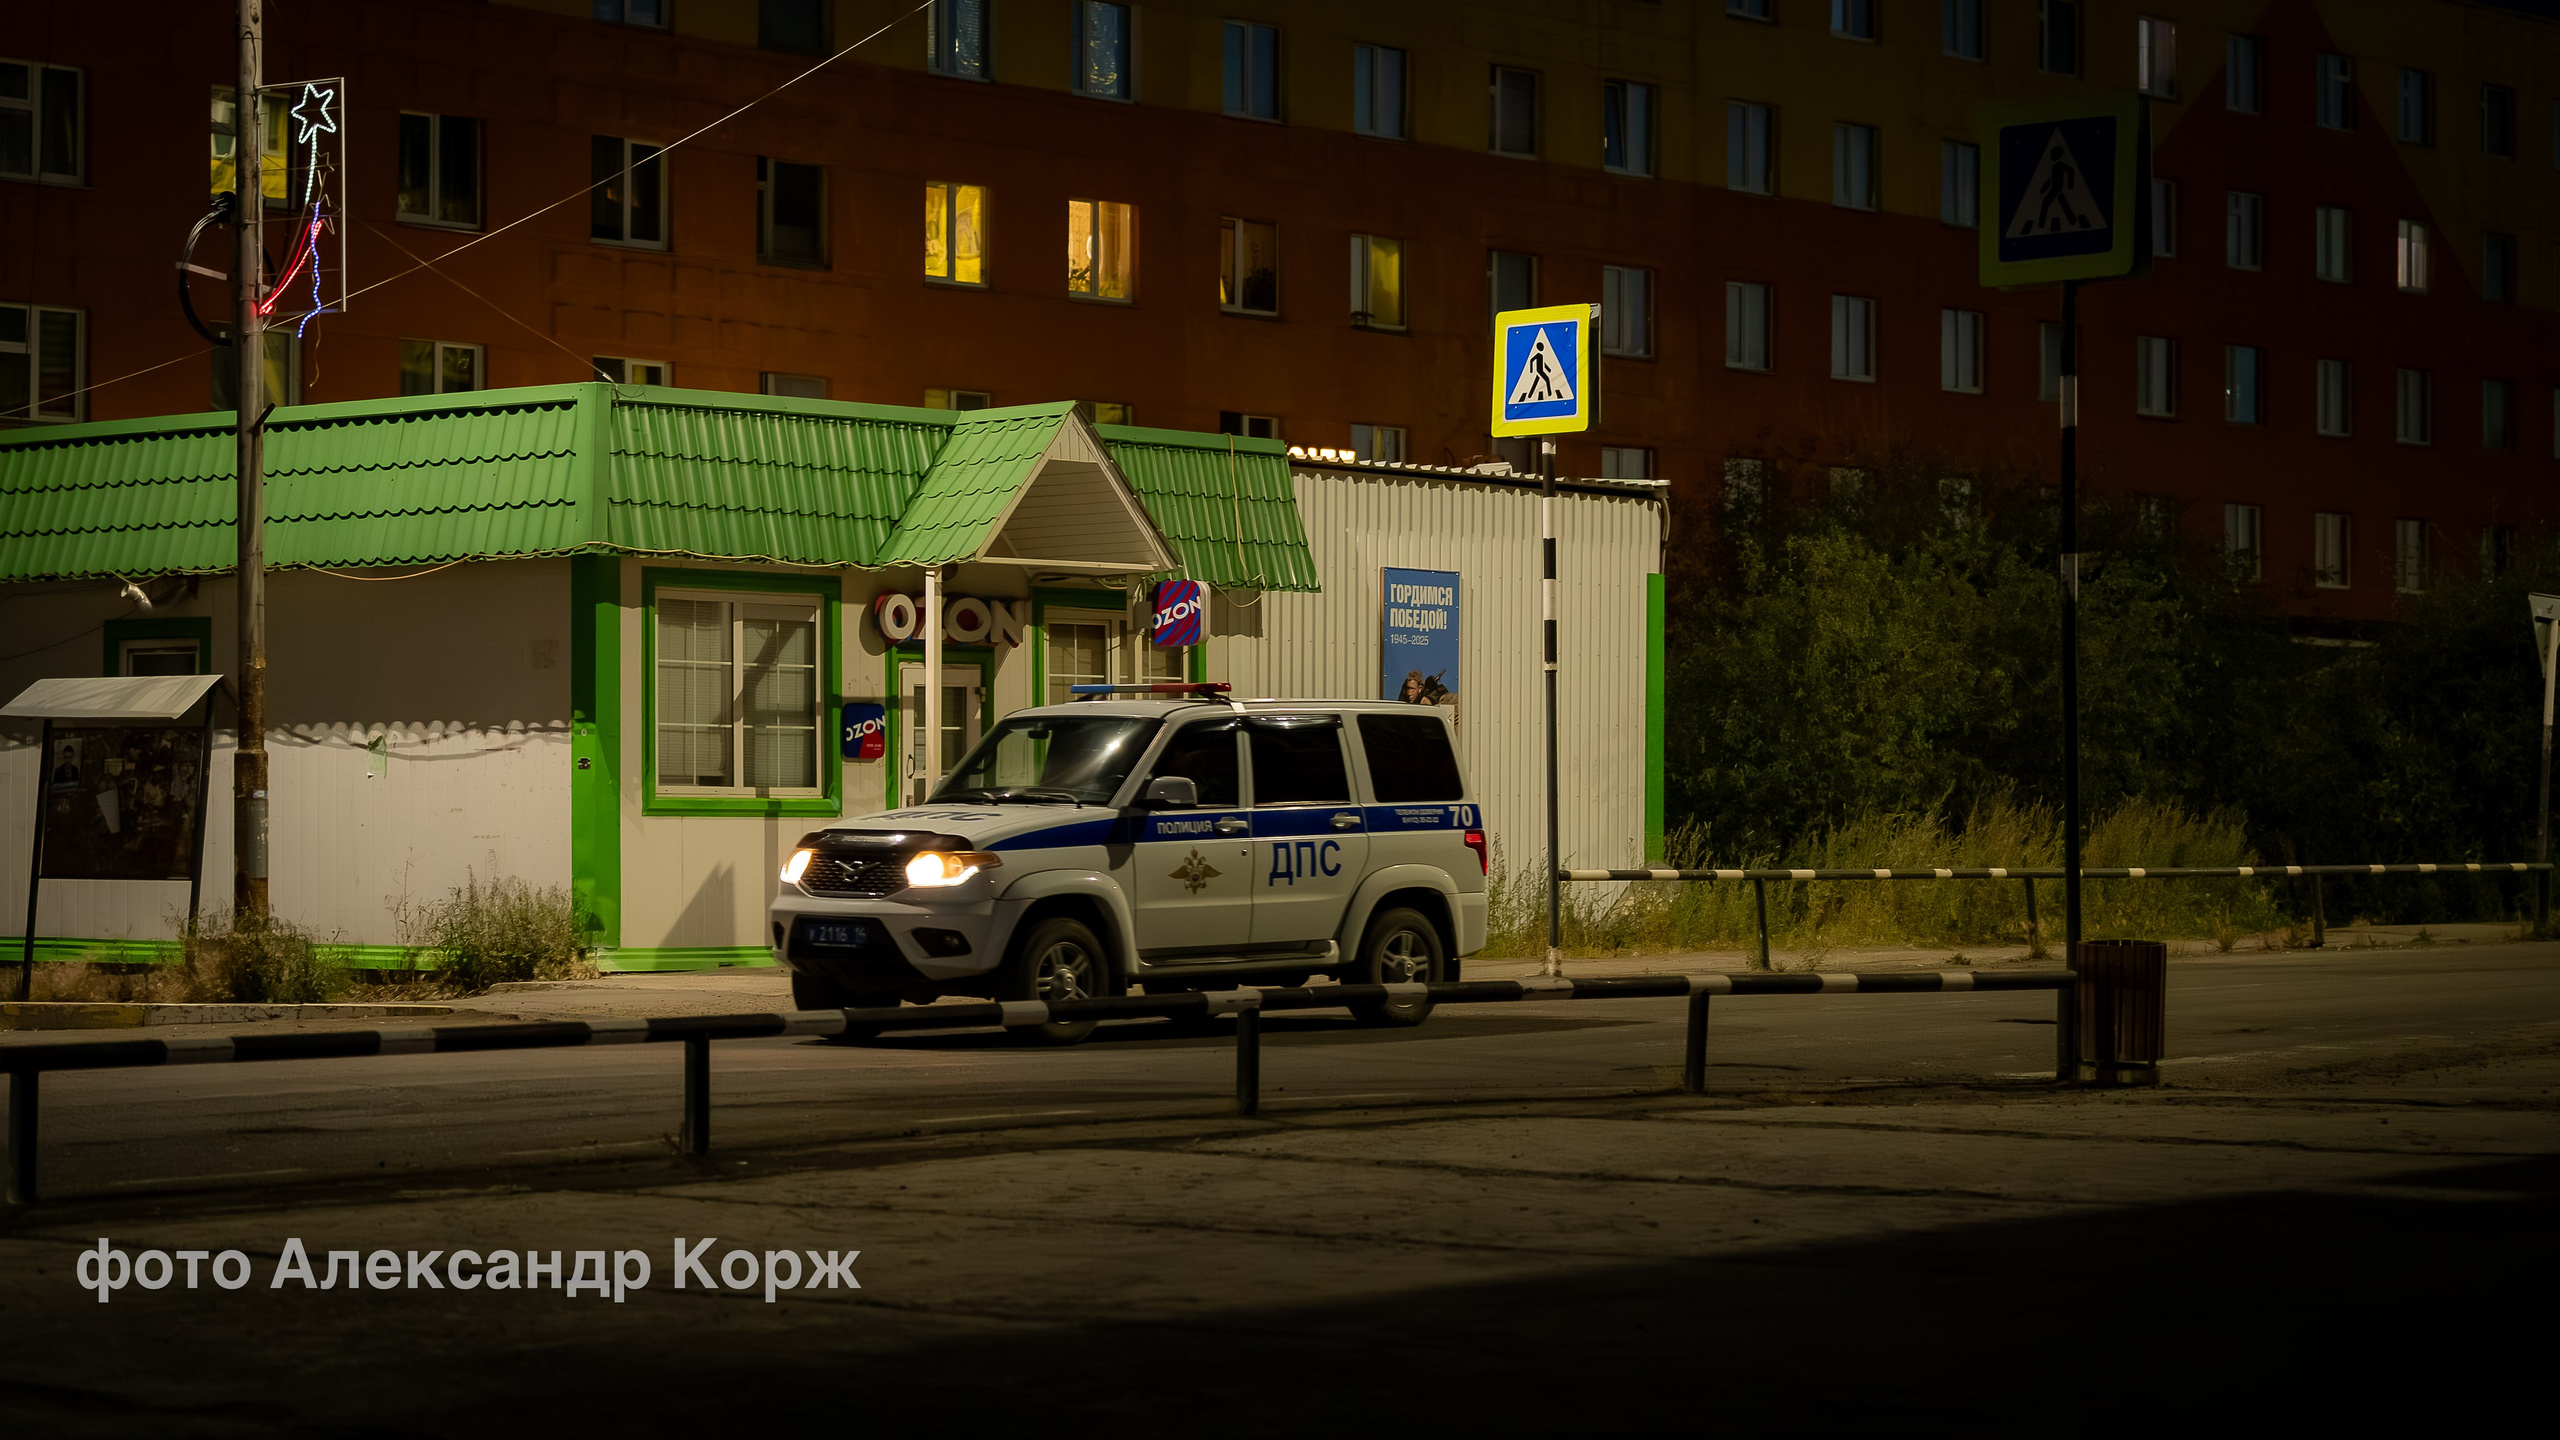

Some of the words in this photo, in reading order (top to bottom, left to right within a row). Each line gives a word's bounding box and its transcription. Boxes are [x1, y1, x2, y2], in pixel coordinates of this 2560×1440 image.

[1390, 583, 1453, 608] ГОРДИМСЯ
[1152, 596, 1201, 630] OZON
[1389, 608, 1448, 632] ПОБЕДОЙ!
[1157, 820, 1213, 835] ПОЛИЦИЯ
[1448, 805, 1473, 827] 70
[1268, 839, 1342, 887] ДПС
